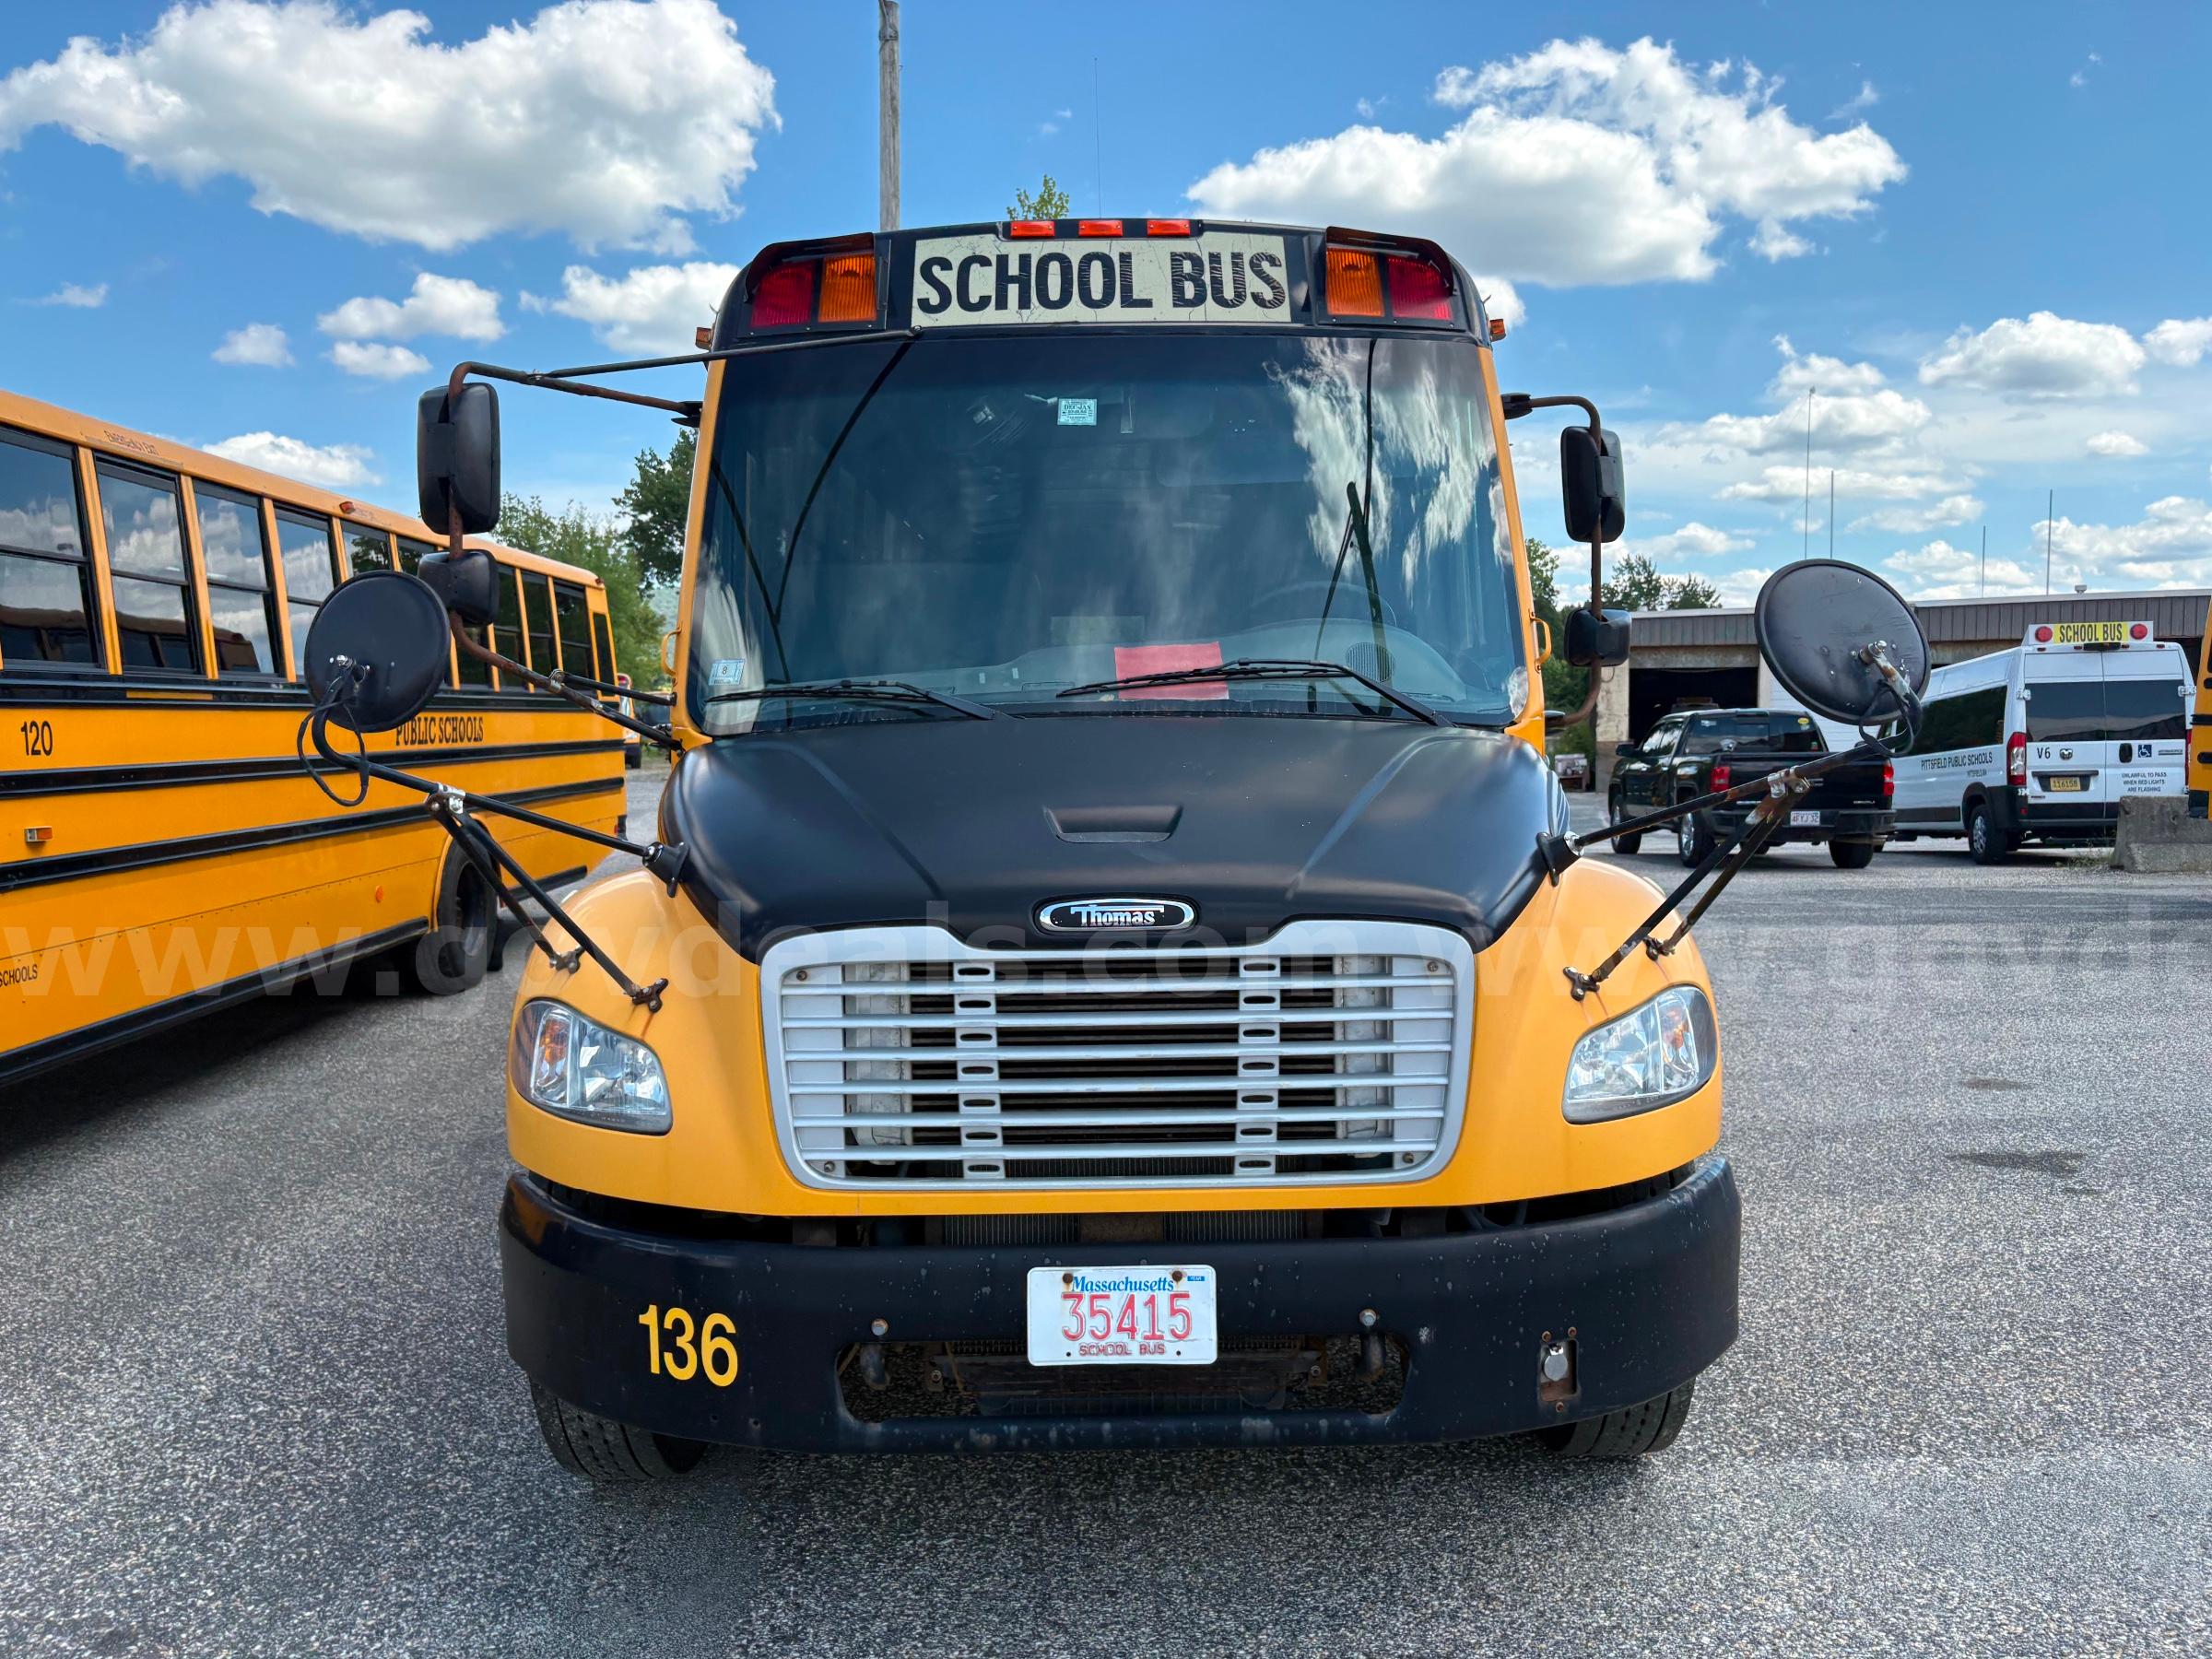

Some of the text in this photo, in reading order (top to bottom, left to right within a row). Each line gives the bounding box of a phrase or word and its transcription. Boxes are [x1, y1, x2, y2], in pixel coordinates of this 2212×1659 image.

[916, 251, 1288, 314] SCHOOL BUS
[2059, 623, 2123, 642] SCHOOL BUS
[20, 721, 53, 756] 120
[395, 716, 484, 746] PUBLIC SCHOOLS
[1921, 751, 1993, 771] PITTSFIELD PUBLIC SCHOOLS
[2037, 747, 2051, 759] V6
[1070, 904, 1164, 927] Thomas
[1071, 1276, 1174, 1292] Massachusetts
[1061, 1291, 1192, 1341] 35415
[638, 1304, 738, 1387] 136
[1079, 1342, 1167, 1356] SCHOOL BUS
